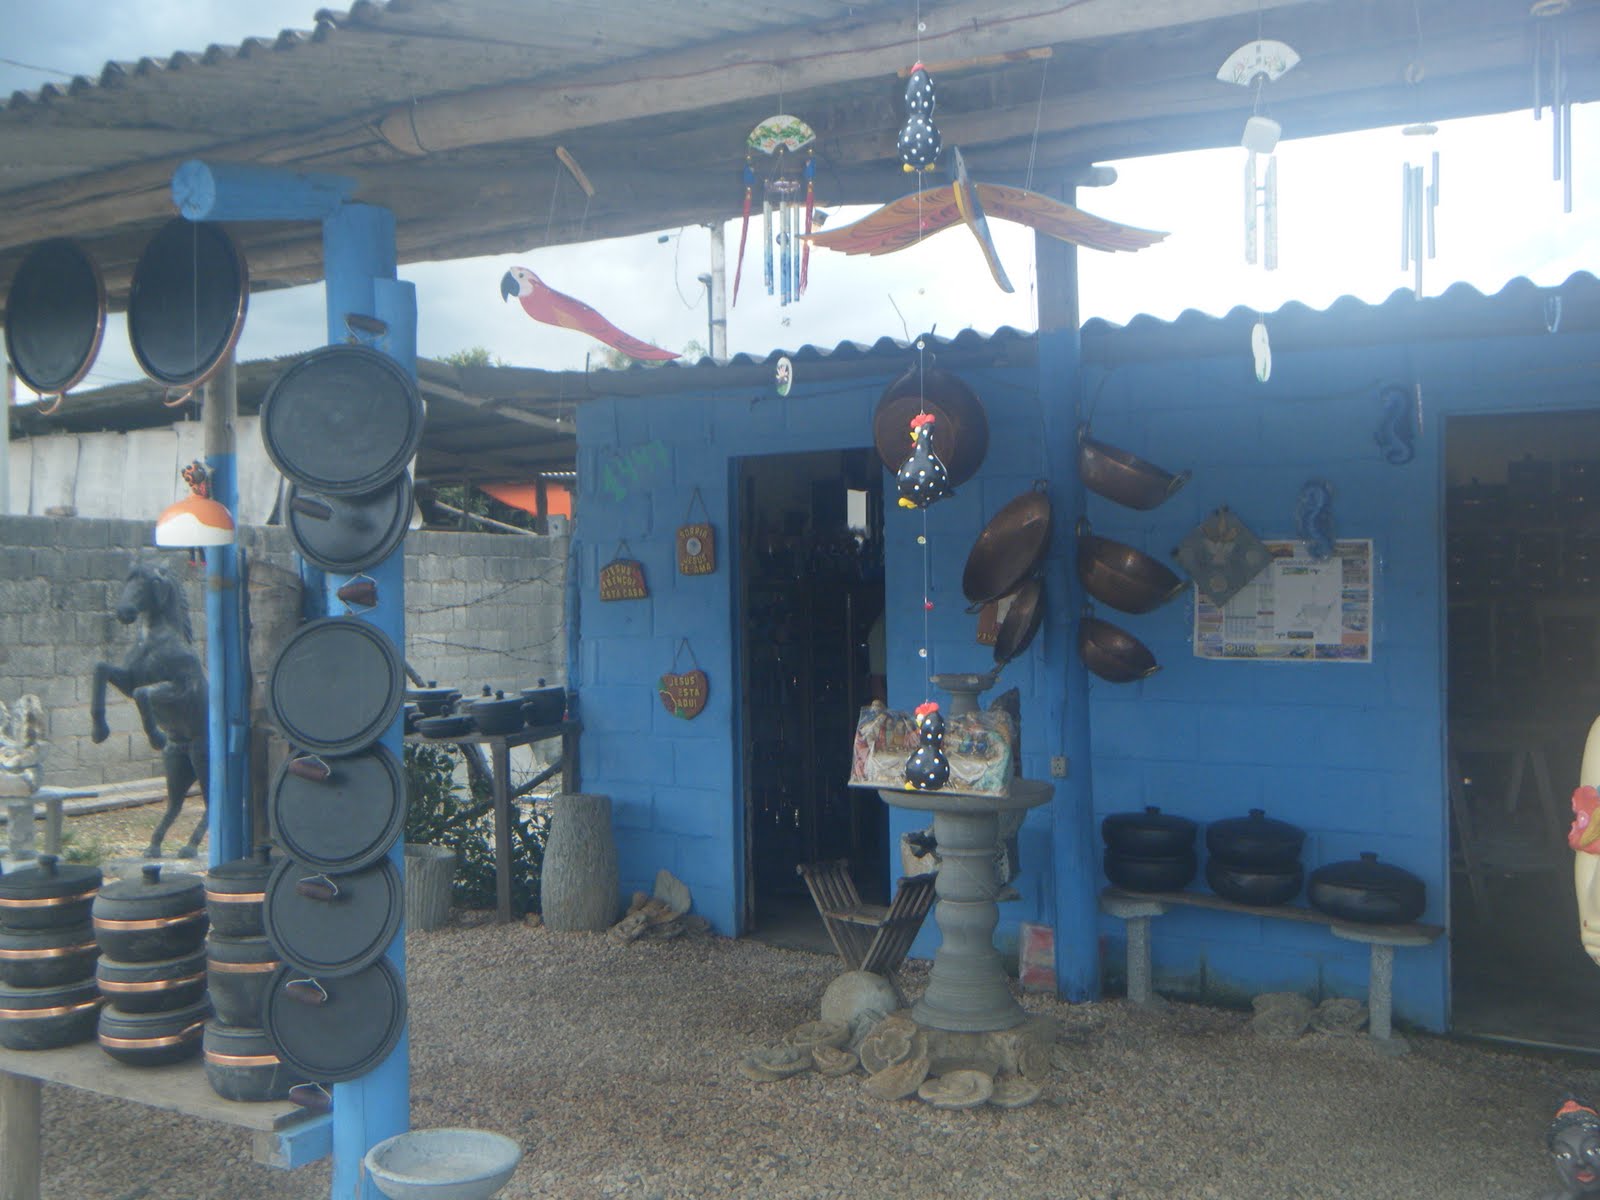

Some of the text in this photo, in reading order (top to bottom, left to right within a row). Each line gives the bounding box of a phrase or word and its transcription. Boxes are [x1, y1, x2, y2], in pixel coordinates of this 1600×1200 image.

[679, 527, 708, 538] SORRIA
[683, 553, 706, 565] JESUS
[606, 563, 631, 577] JESUS
[680, 561, 712, 574] TE AMA
[601, 587, 644, 599] ESTA CASA
[670, 676, 696, 686] JESUS
[679, 687, 700, 697] ESTA
[677, 698, 697, 708] AQUI
